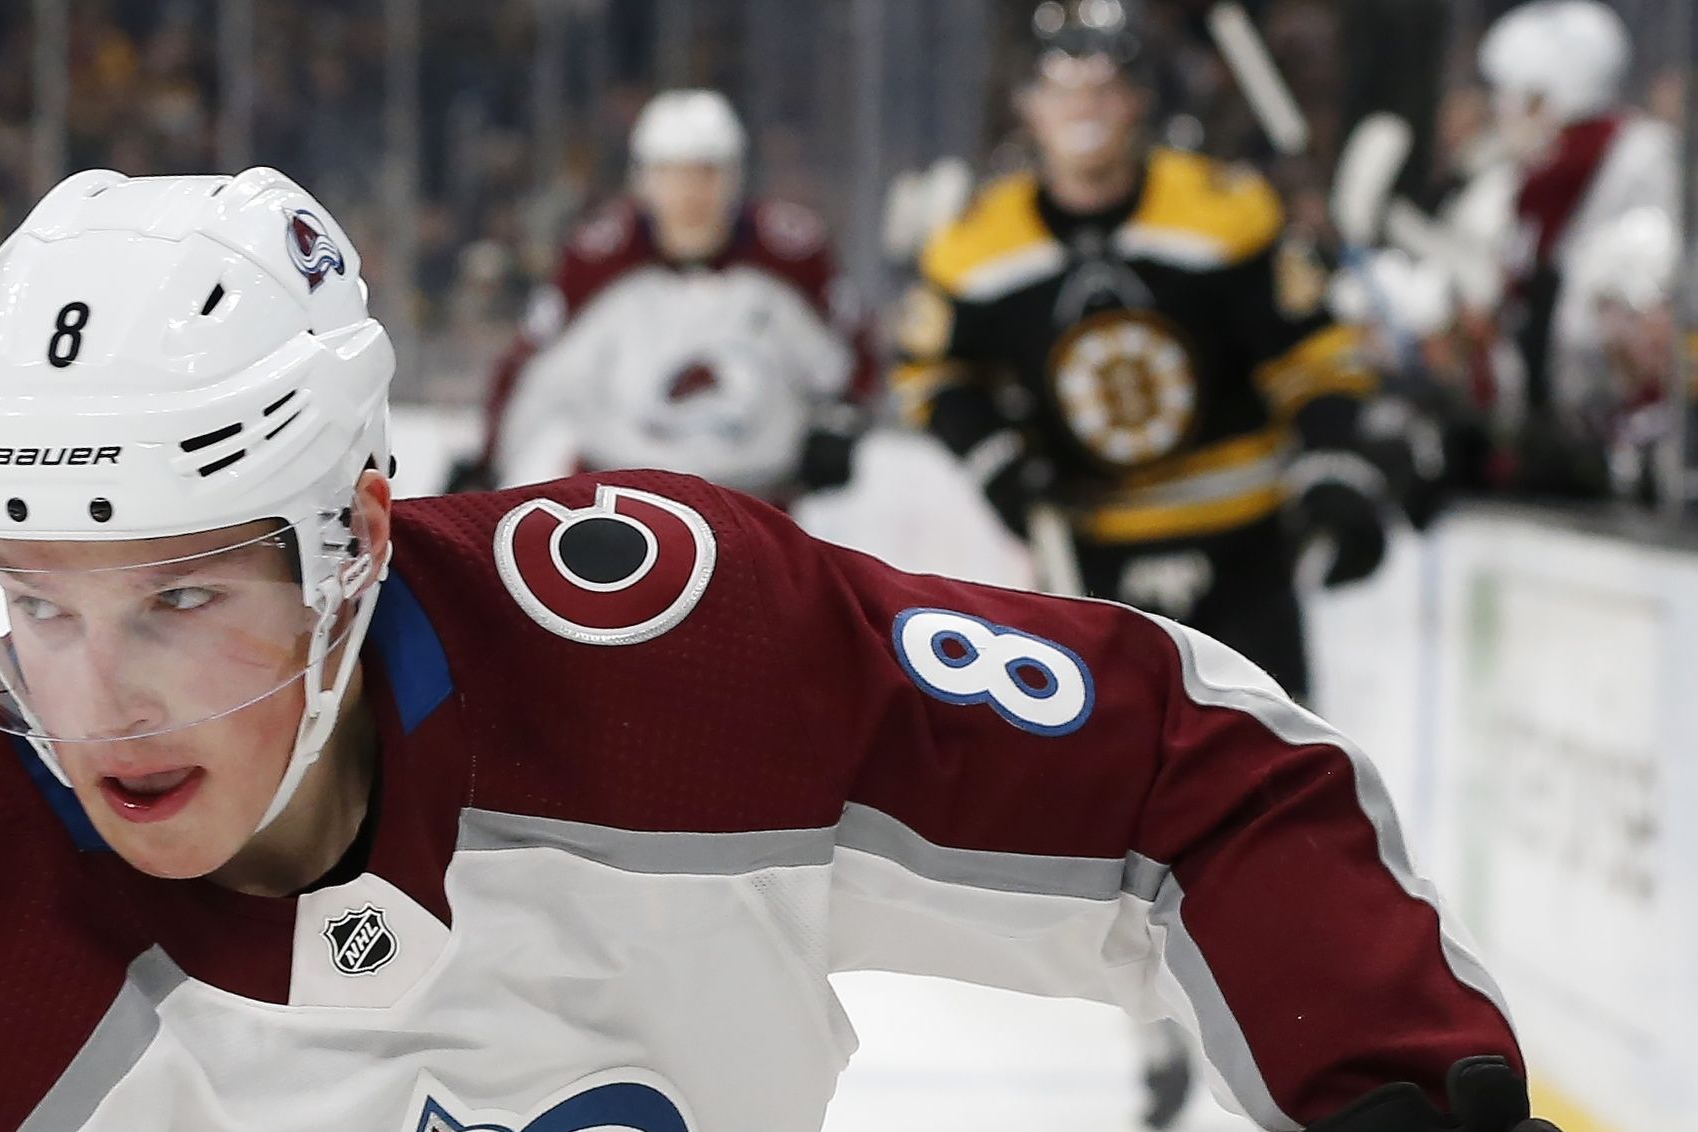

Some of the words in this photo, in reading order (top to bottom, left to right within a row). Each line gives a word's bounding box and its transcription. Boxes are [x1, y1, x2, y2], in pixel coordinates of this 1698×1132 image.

[48, 302, 89, 368] 8
[892, 607, 1095, 737] 8
[345, 921, 379, 966] NHL
